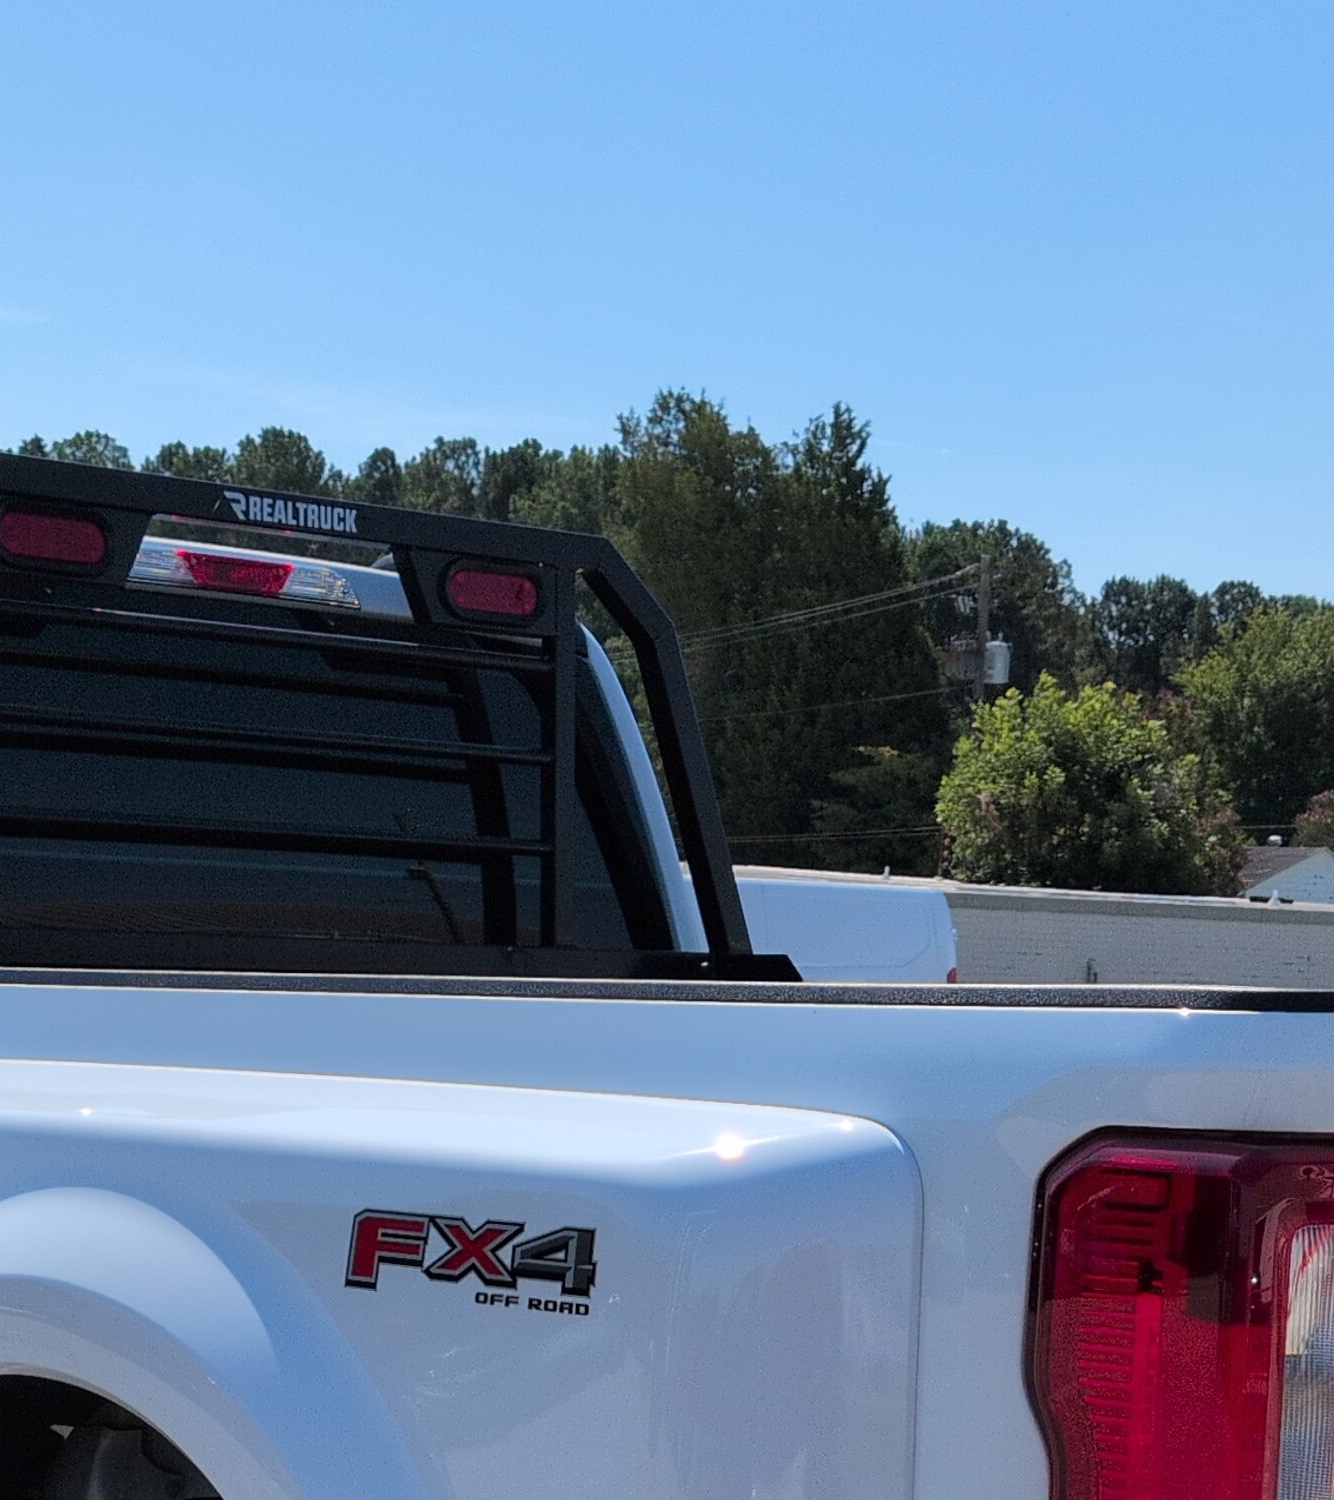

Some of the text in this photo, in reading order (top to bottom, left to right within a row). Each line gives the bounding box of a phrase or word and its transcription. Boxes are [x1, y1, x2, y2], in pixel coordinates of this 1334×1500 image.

[249, 496, 358, 533] REALTRUCK
[344, 1207, 598, 1298] FX4
[474, 1291, 590, 1317] OFF ROAD
